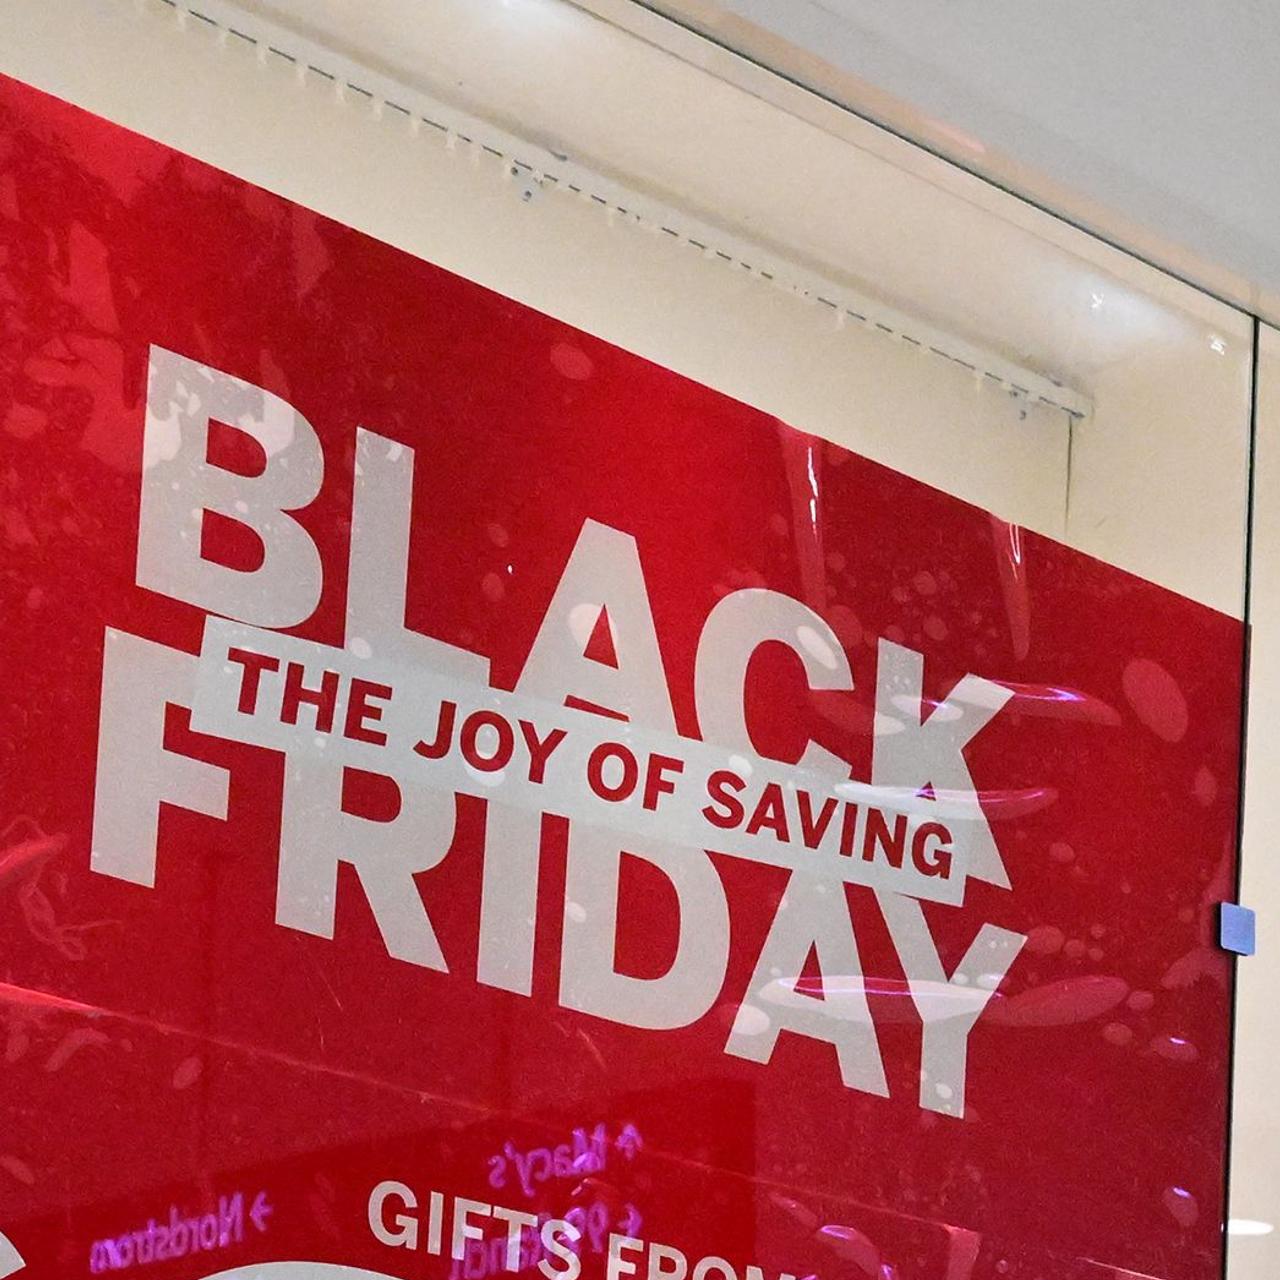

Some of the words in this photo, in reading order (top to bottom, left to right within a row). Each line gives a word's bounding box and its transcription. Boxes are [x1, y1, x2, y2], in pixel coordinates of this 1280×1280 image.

[135, 343, 1016, 888] BLACK
[227, 646, 394, 749] THE
[413, 697, 568, 786] JOY
[586, 722, 684, 812] OF
[701, 766, 956, 881] SAVING
[89, 626, 1028, 1119] FRIDAY
